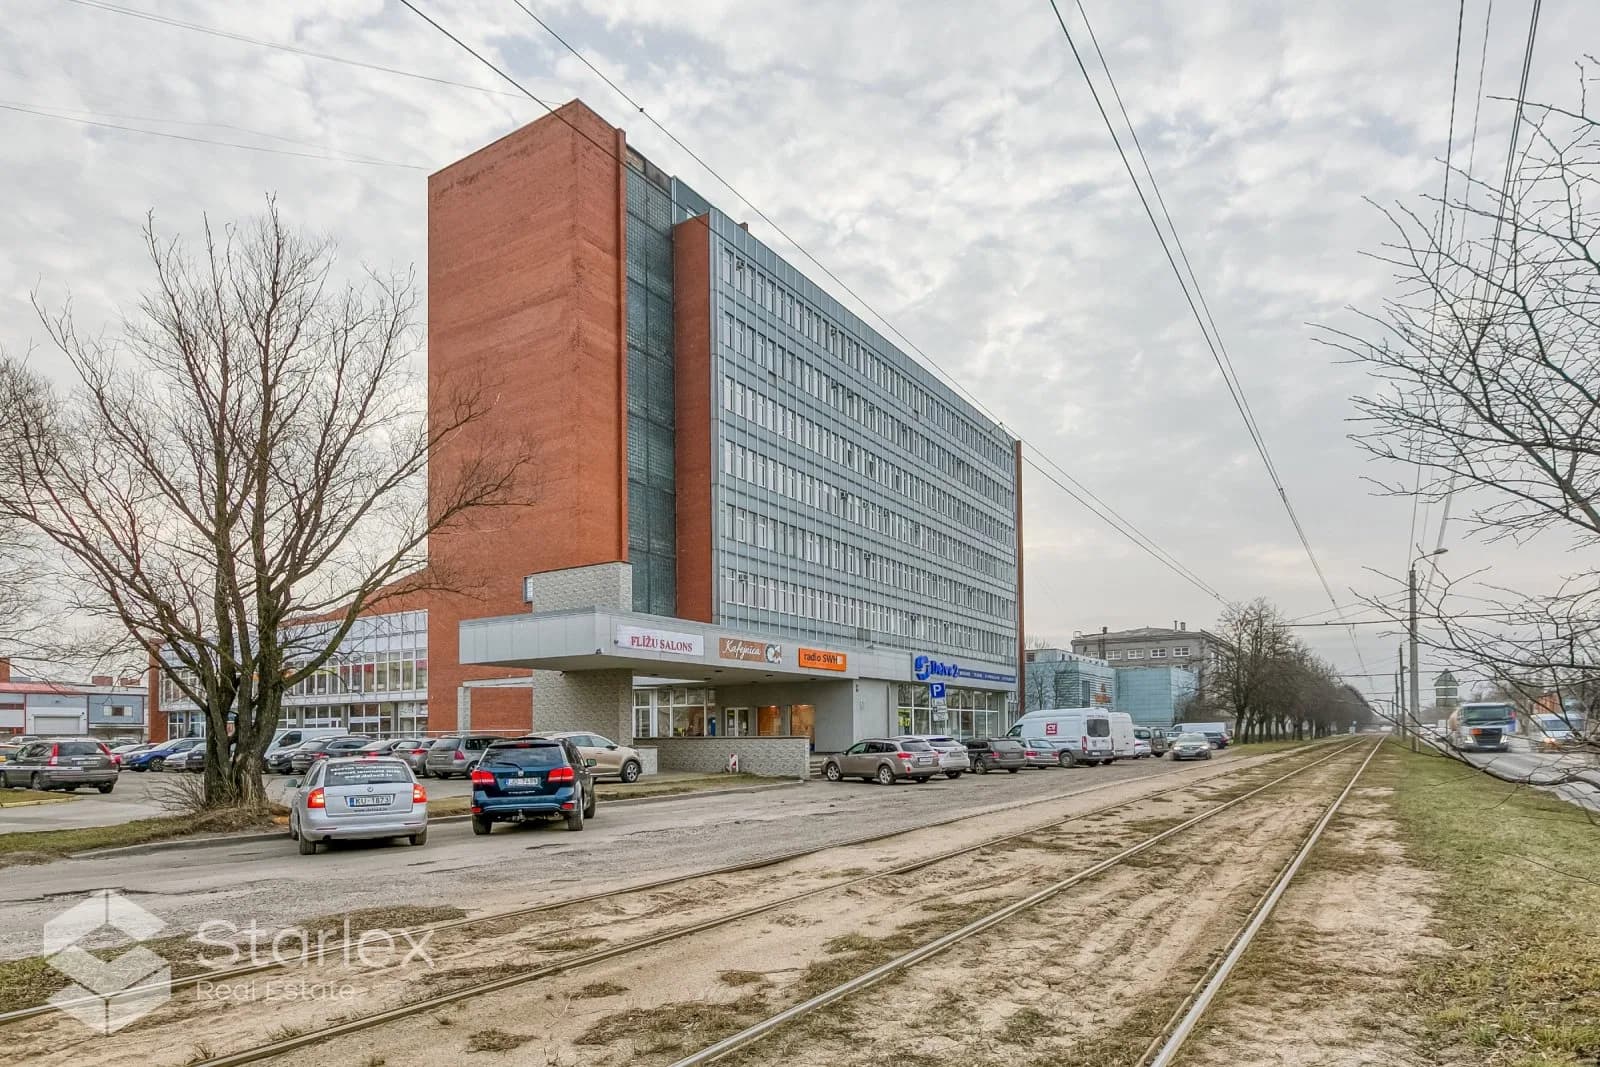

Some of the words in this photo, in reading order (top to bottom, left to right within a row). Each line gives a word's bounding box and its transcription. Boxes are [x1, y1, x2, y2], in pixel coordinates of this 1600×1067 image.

[660, 639, 693, 652] SALONS
[804, 652, 821, 662] radio
[822, 654, 838, 665] SWH
[933, 684, 942, 697] P
